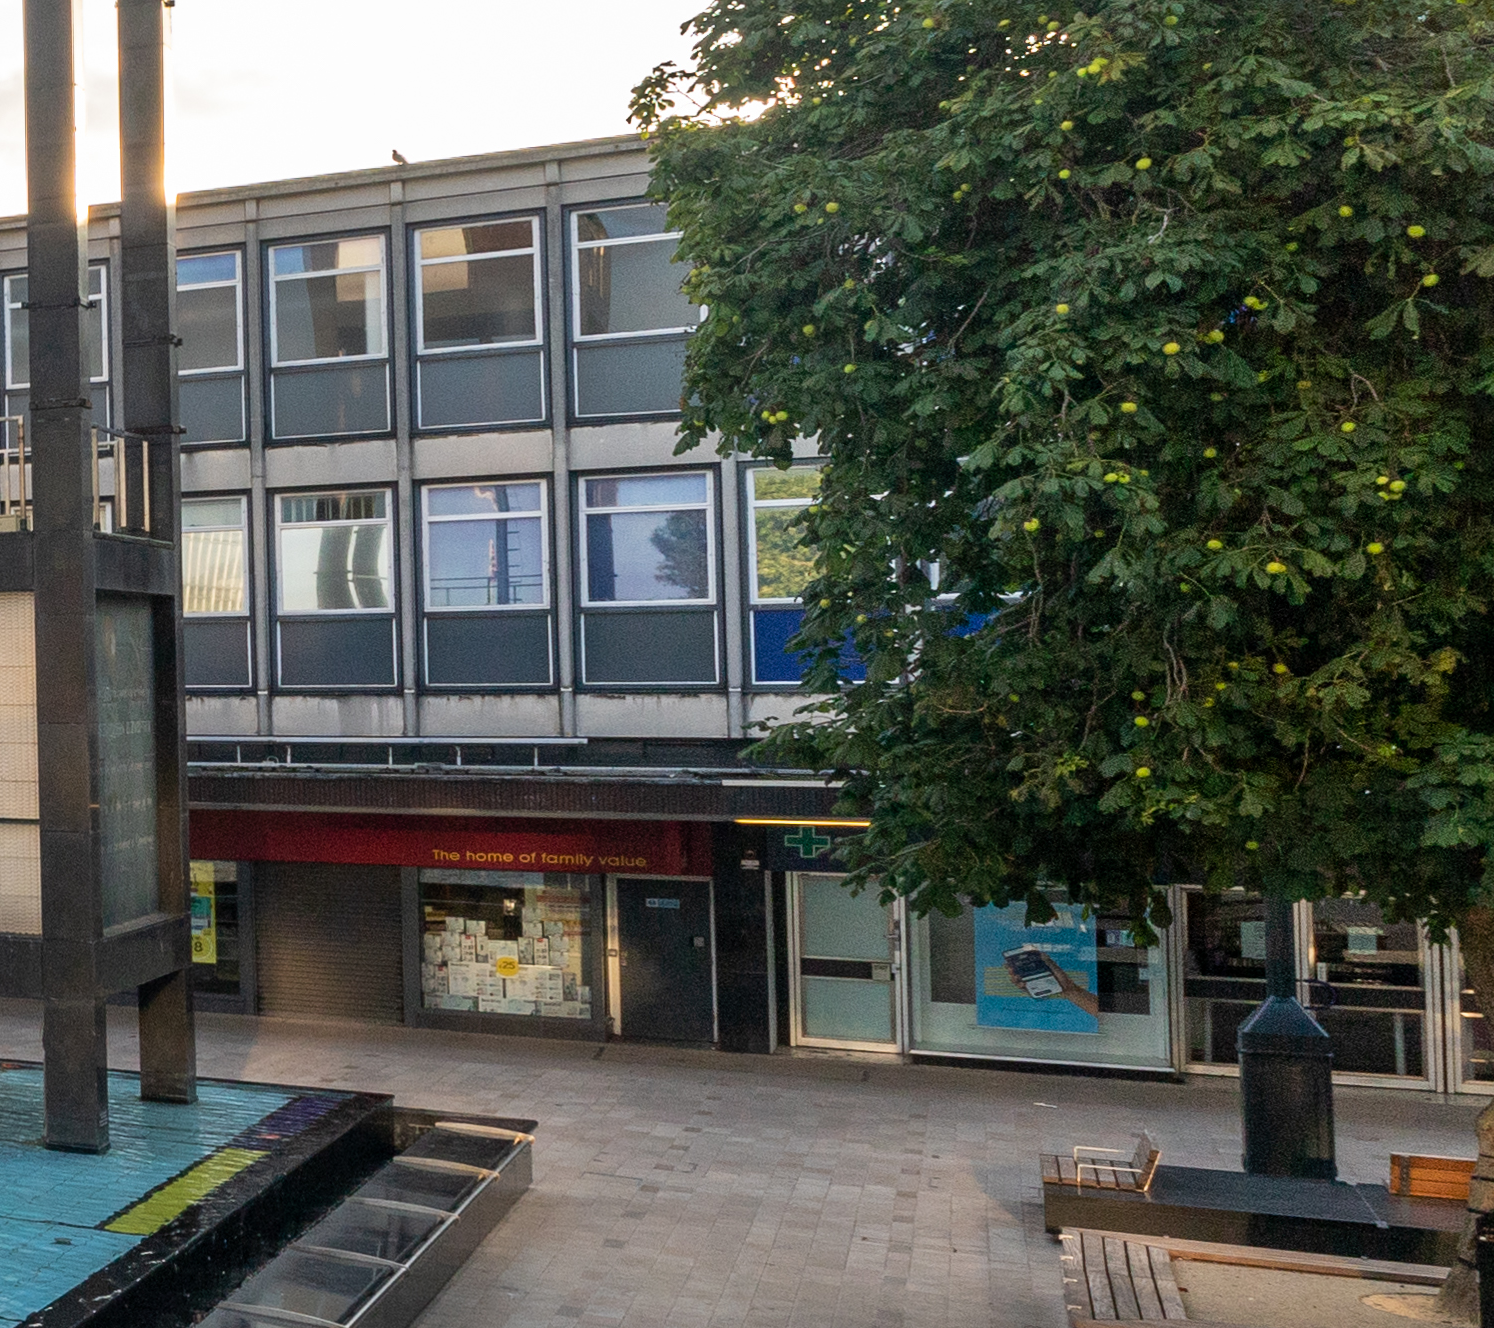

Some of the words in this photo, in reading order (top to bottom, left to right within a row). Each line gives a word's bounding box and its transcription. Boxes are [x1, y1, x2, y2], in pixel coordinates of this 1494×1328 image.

[432, 849, 460, 862] The
[466, 850, 513, 863] home
[519, 852, 536, 863] of
[541, 852, 594, 867] family
[599, 855, 647, 867] value
